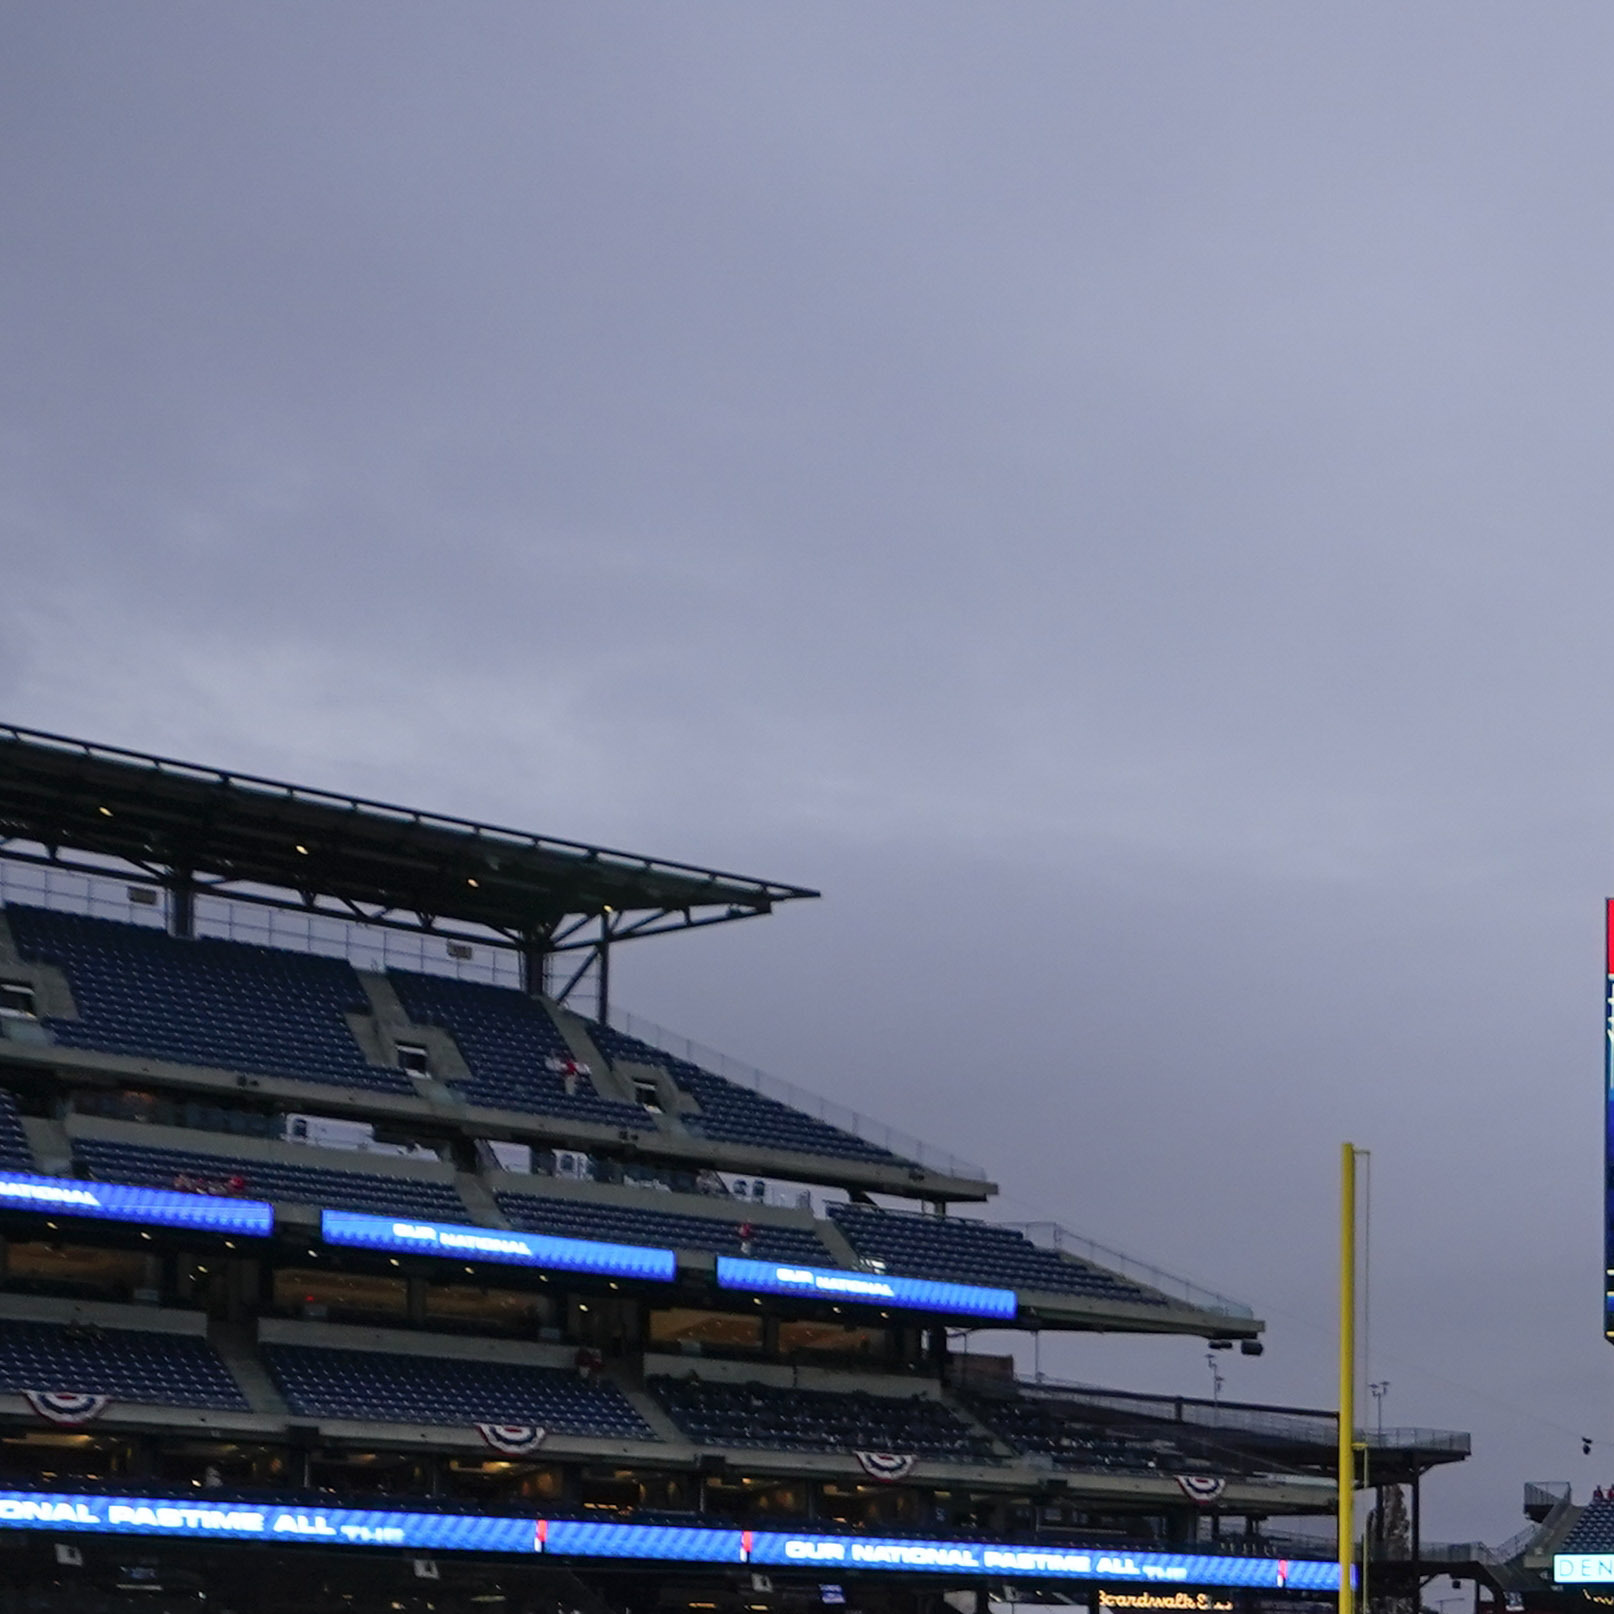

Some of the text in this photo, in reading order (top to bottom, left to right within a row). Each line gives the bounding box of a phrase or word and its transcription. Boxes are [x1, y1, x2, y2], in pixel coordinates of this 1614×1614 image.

[108, 1505, 264, 1532] PASTIME
[273, 1514, 337, 1535] ALL
[785, 1539, 844, 1560] OUR
[852, 1544, 979, 1567] NATIONAL
[984, 1551, 1090, 1573] PASTIME
[1097, 1557, 1140, 1575] ALL
